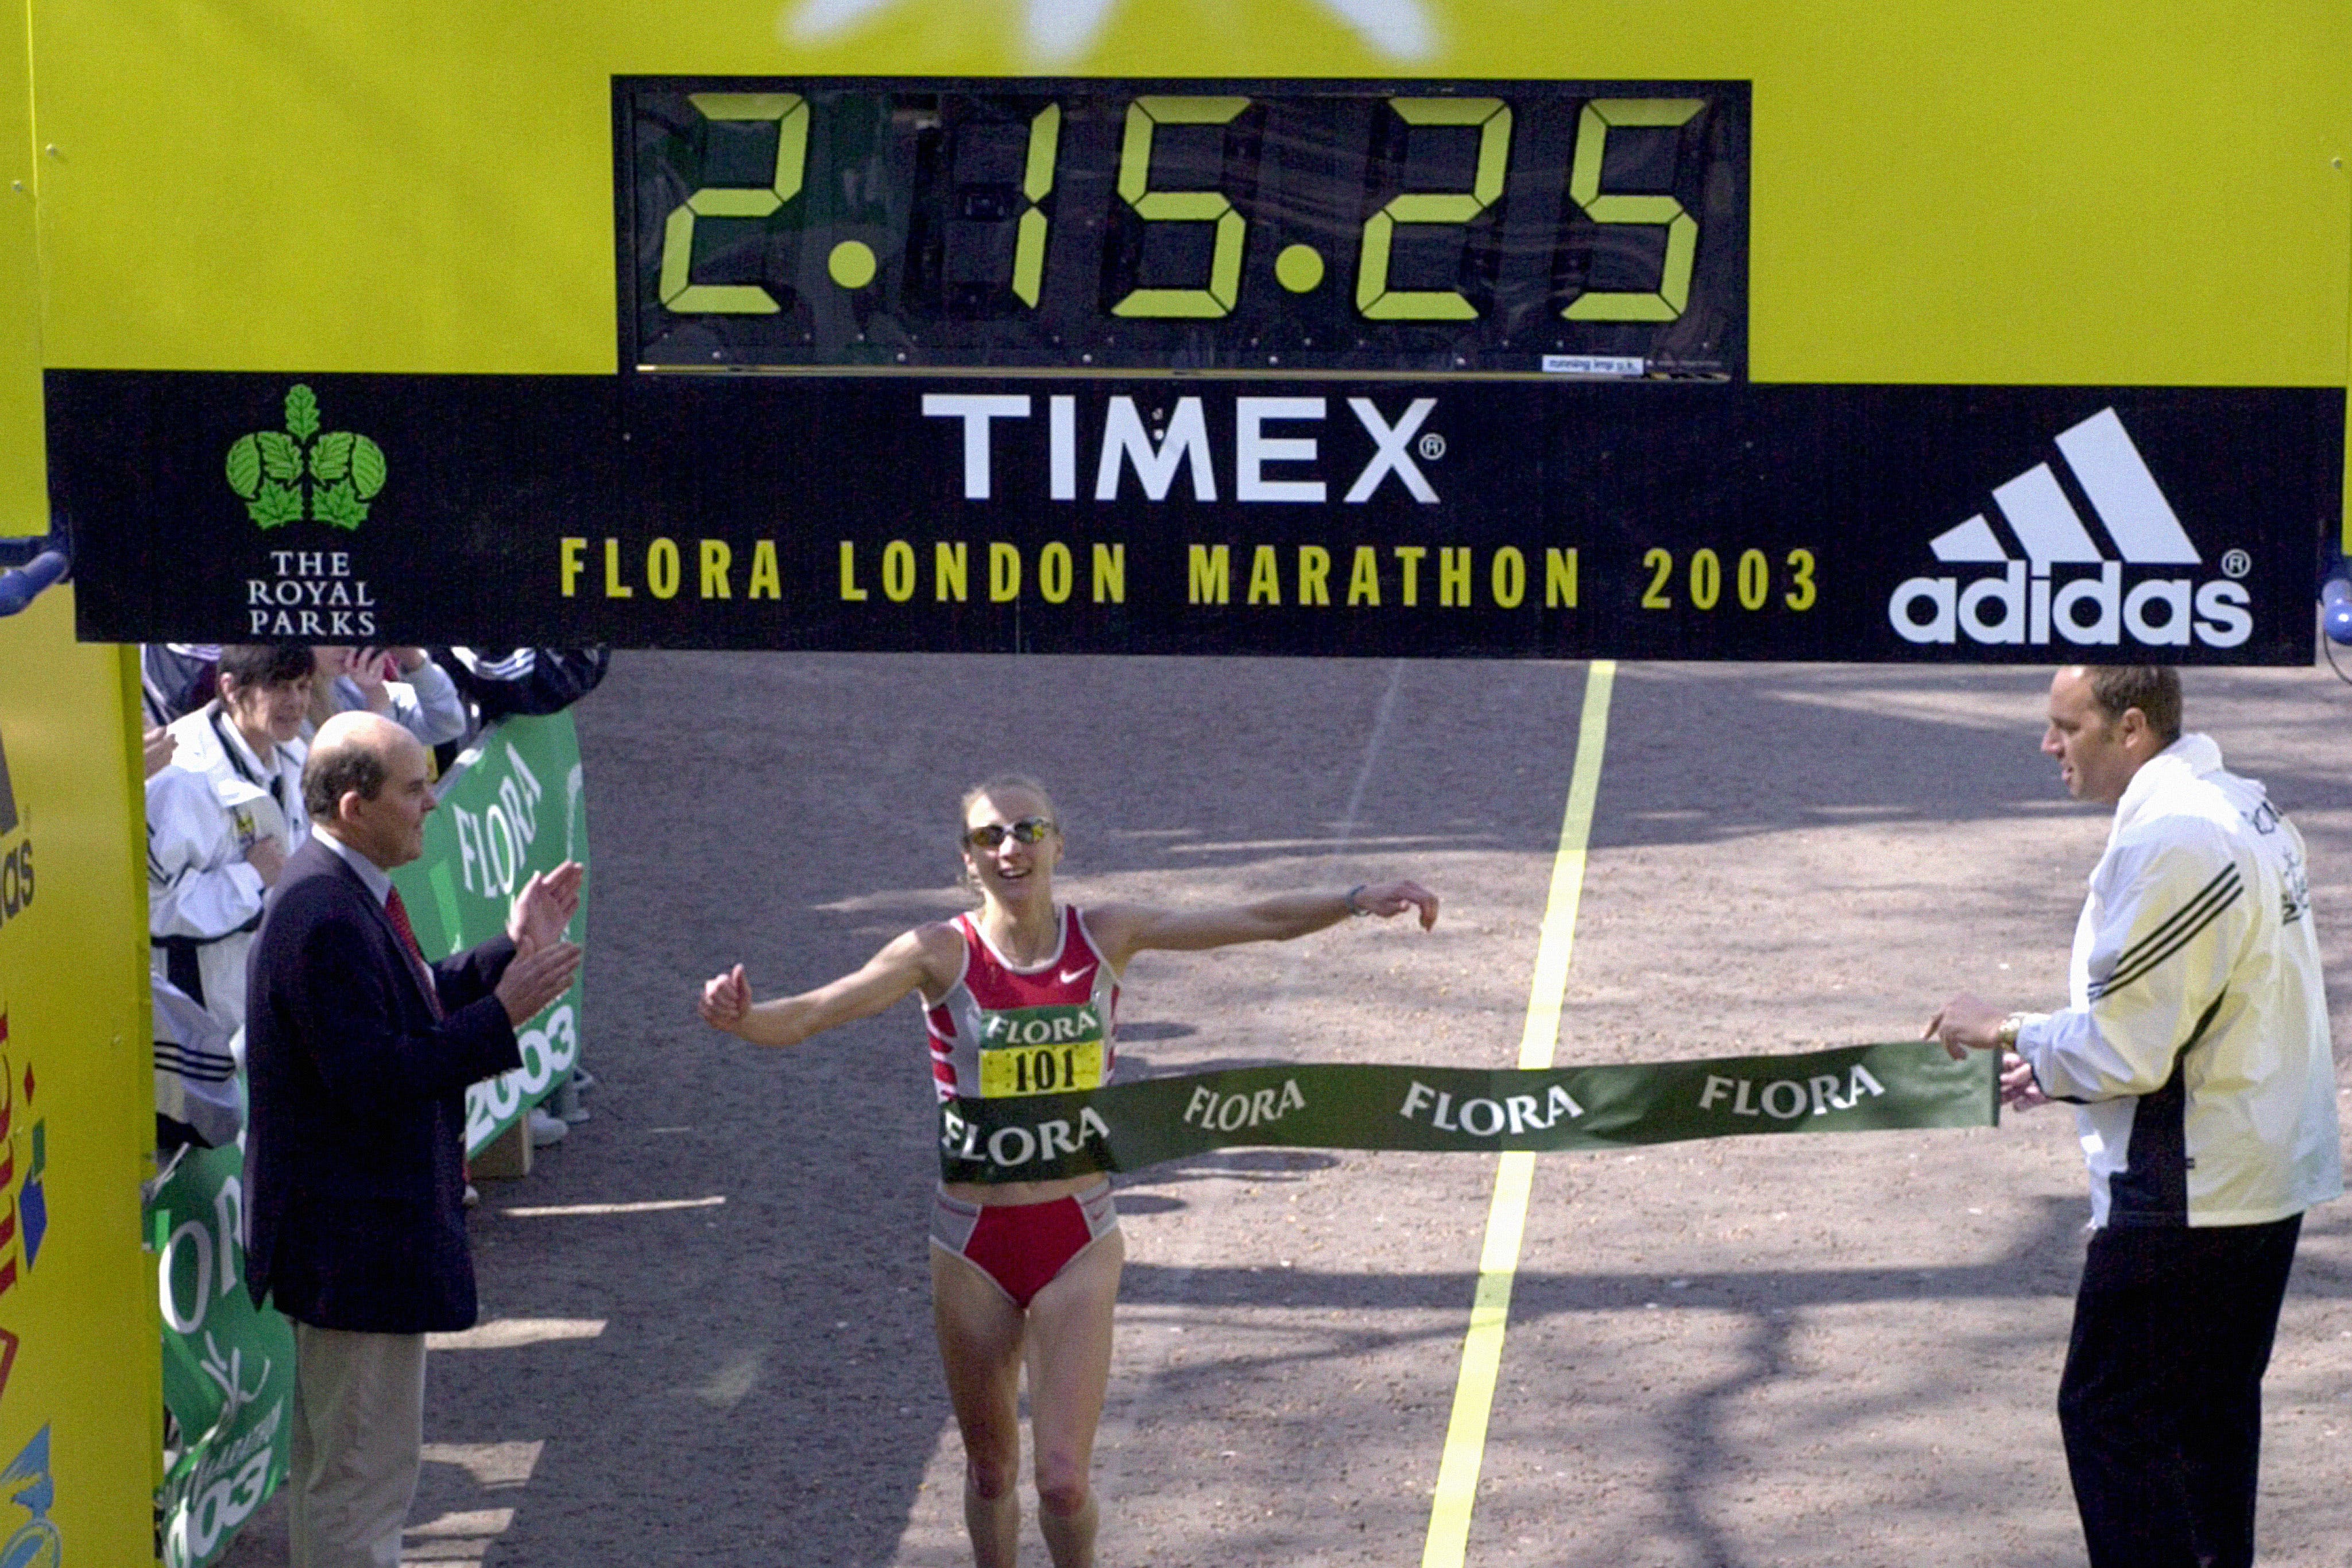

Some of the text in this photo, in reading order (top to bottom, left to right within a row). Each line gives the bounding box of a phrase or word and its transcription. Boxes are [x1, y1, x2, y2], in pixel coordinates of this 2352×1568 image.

[270, 551, 350, 577] THE
[560, 537, 1817, 610] FLORA LONDON MARATHON 2003
[247, 580, 375, 606] ROYAL
[1888, 559, 2254, 648] adidas
[250, 610, 376, 636] PARKS
[452, 742, 542, 898] FLORA
[985, 1011, 1098, 1044] FLORA
[1015, 1048, 1075, 1092] 101
[1699, 1063, 1886, 1119] FLORA
[1183, 1078, 1305, 1131] FLORA
[1399, 1081, 1585, 1137] FLORA
[942, 1106, 1110, 1166] FLORA
